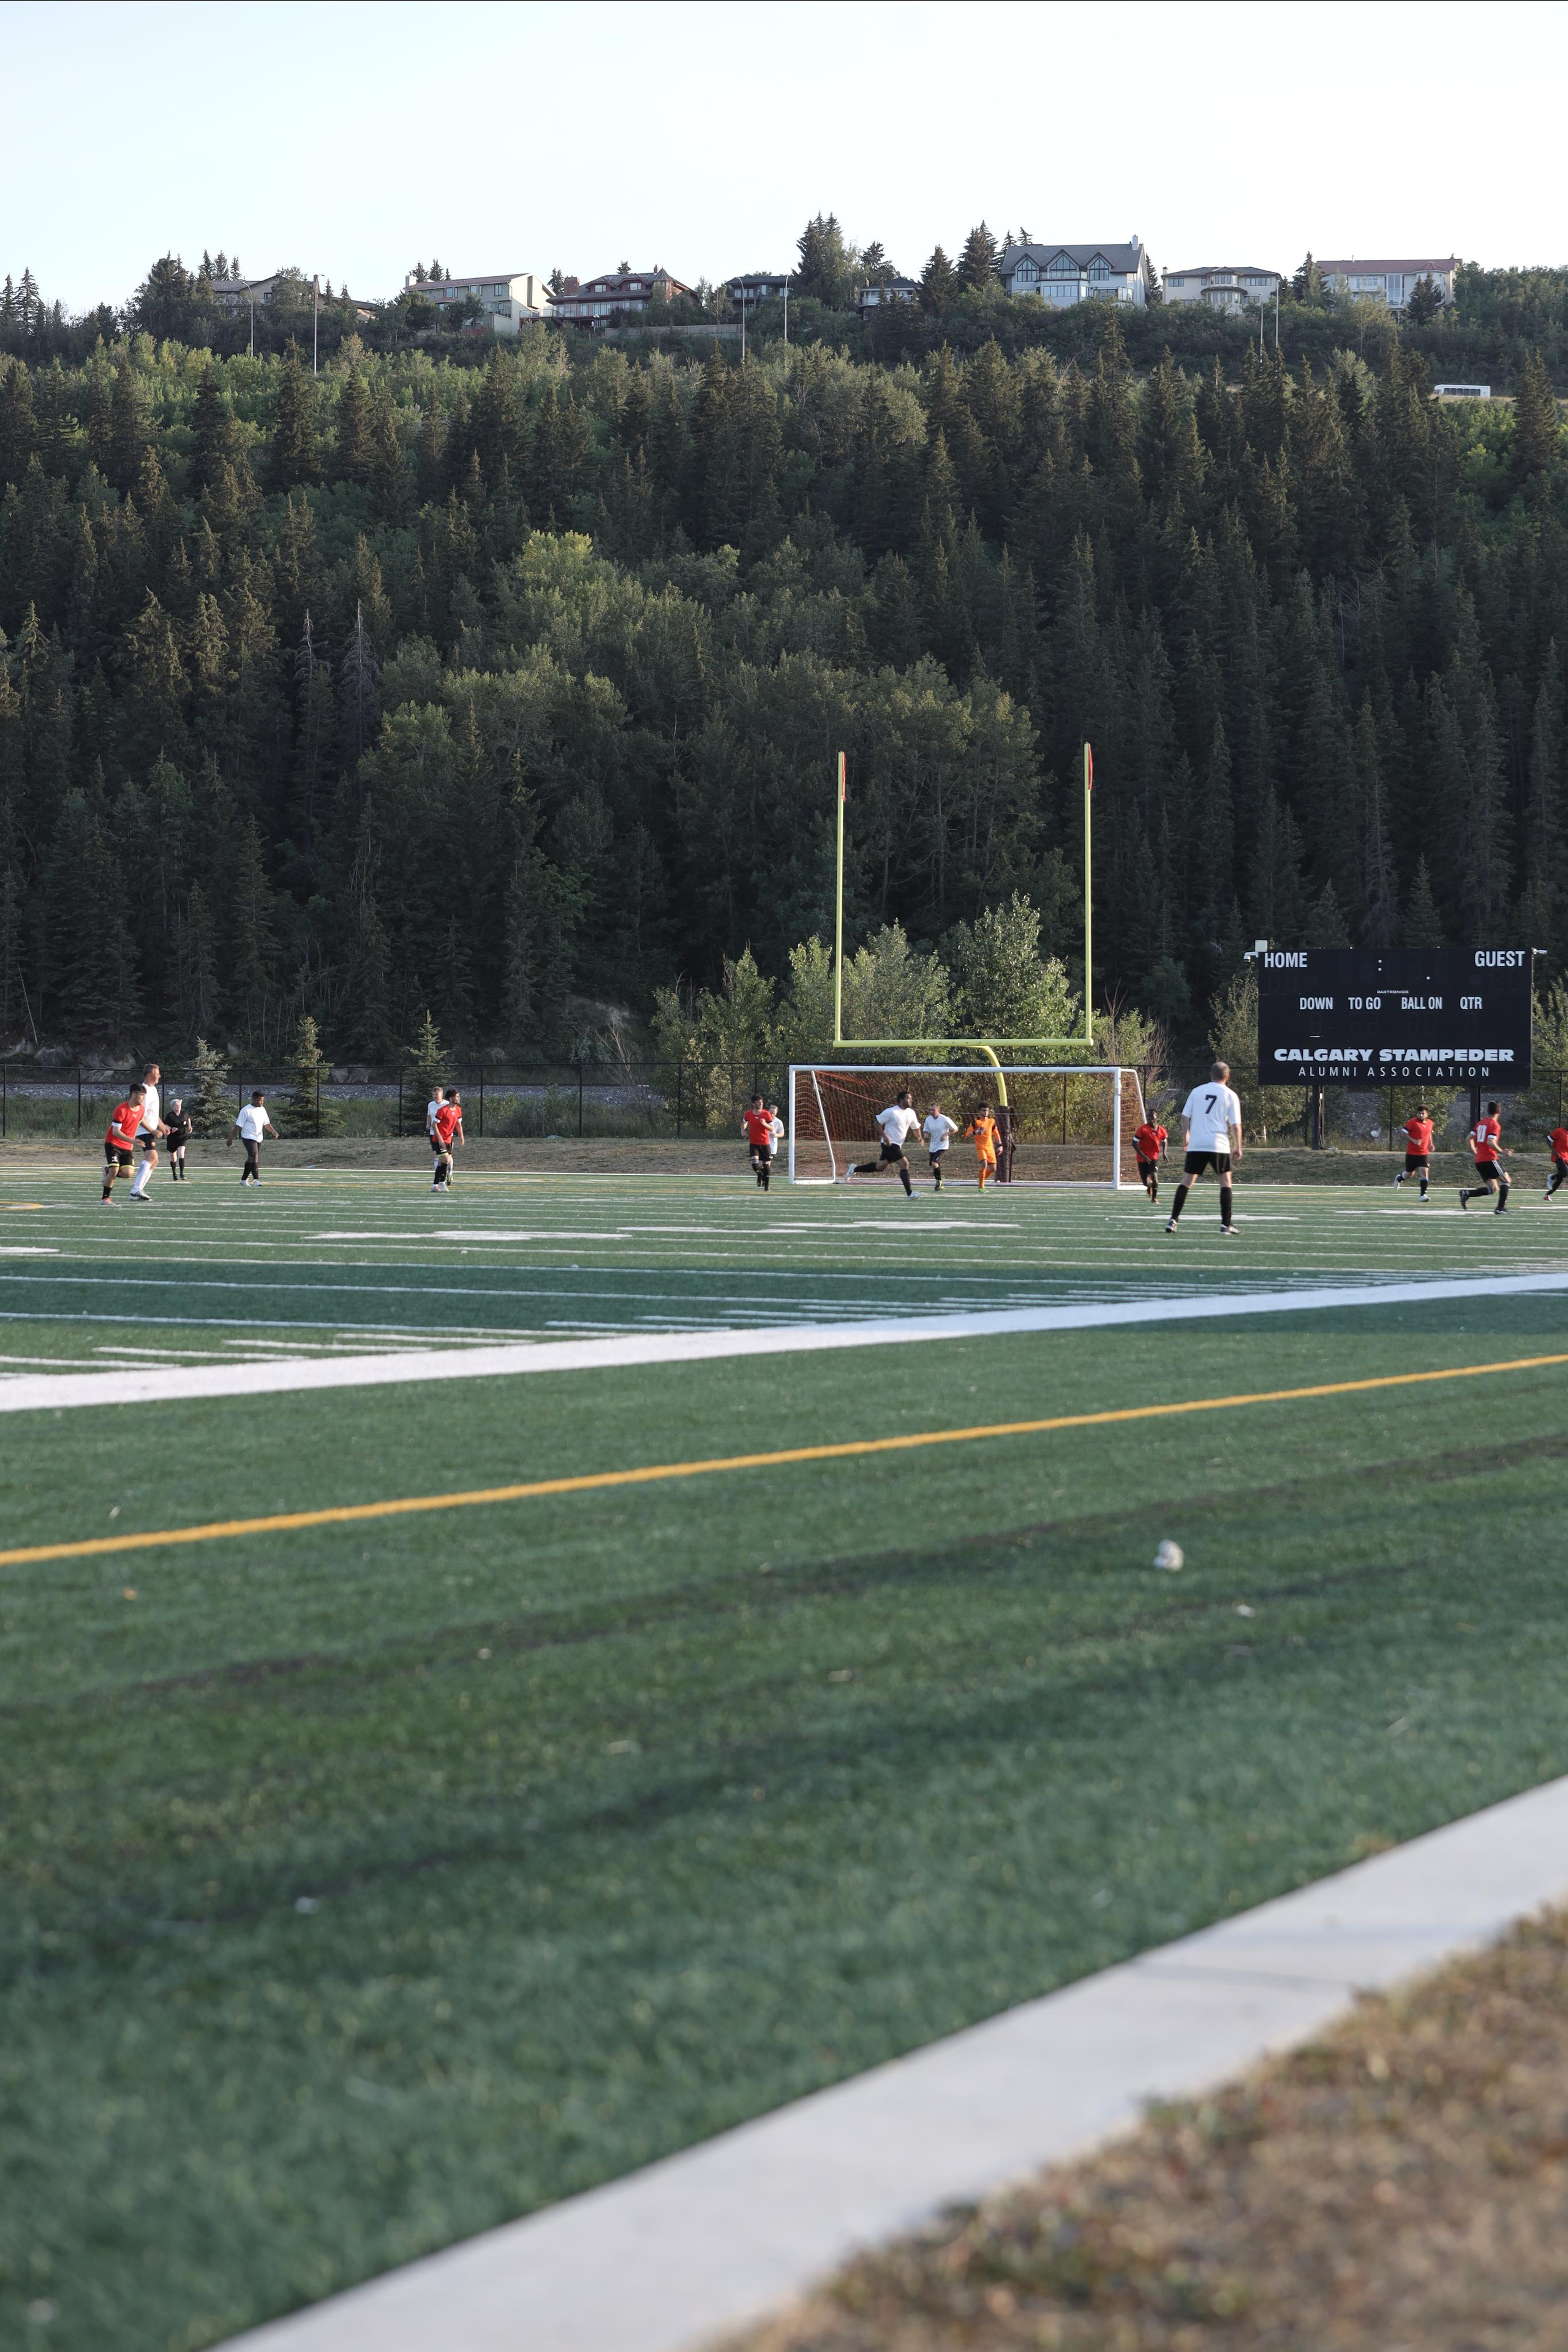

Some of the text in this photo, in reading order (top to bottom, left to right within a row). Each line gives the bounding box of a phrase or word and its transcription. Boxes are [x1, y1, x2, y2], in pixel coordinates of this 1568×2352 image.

[1264, 952, 1307, 968] HOME
[1475, 951, 1525, 967] GUEST
[1299, 997, 1333, 1010] DOWN
[1348, 996, 1381, 1010] TO GO
[1401, 996, 1442, 1010] BALL ON
[1460, 996, 1483, 1011] QTR
[1273, 1048, 1514, 1062] CALGARY STAMPEDER
[1298, 1066, 1490, 1077] ALUMNI ASSOCIATION
[1205, 1095, 1217, 1114] 7
[1476, 1124, 1487, 1143] 10
